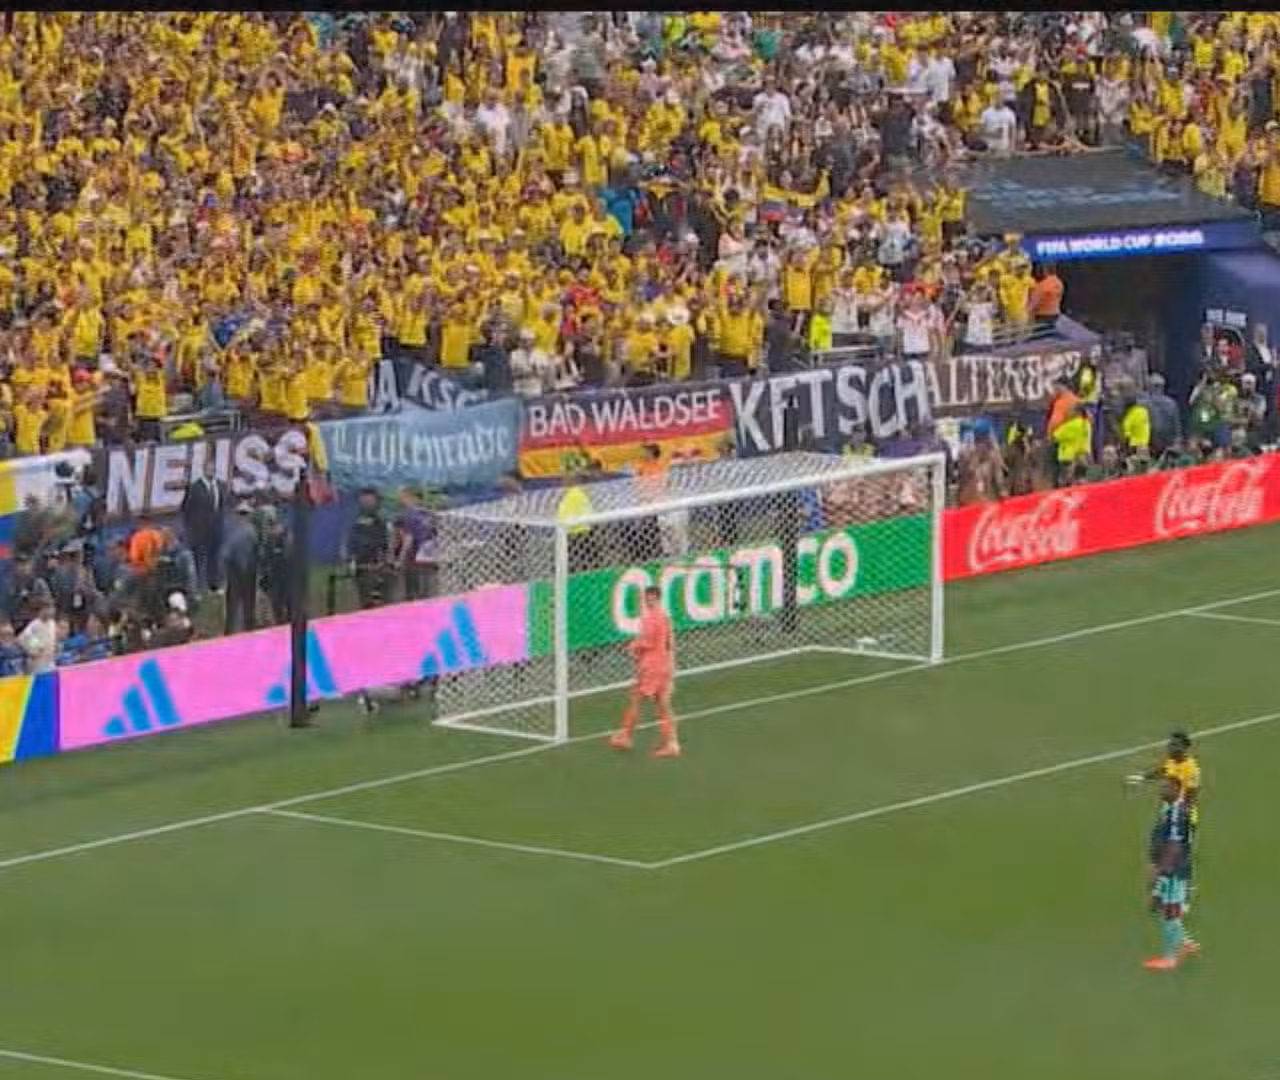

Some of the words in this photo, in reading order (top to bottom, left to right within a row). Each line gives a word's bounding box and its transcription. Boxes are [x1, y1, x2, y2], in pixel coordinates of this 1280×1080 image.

[1036, 240, 1067, 256] FIFA
[1069, 236, 1122, 253] WORLD
[528, 399, 586, 440] BAD
[591, 387, 721, 436] WALDSEE
[970, 492, 1087, 571] Coca-Cola
[1154, 457, 1267, 537] Coca-Cola
[612, 531, 859, 634] aramco
